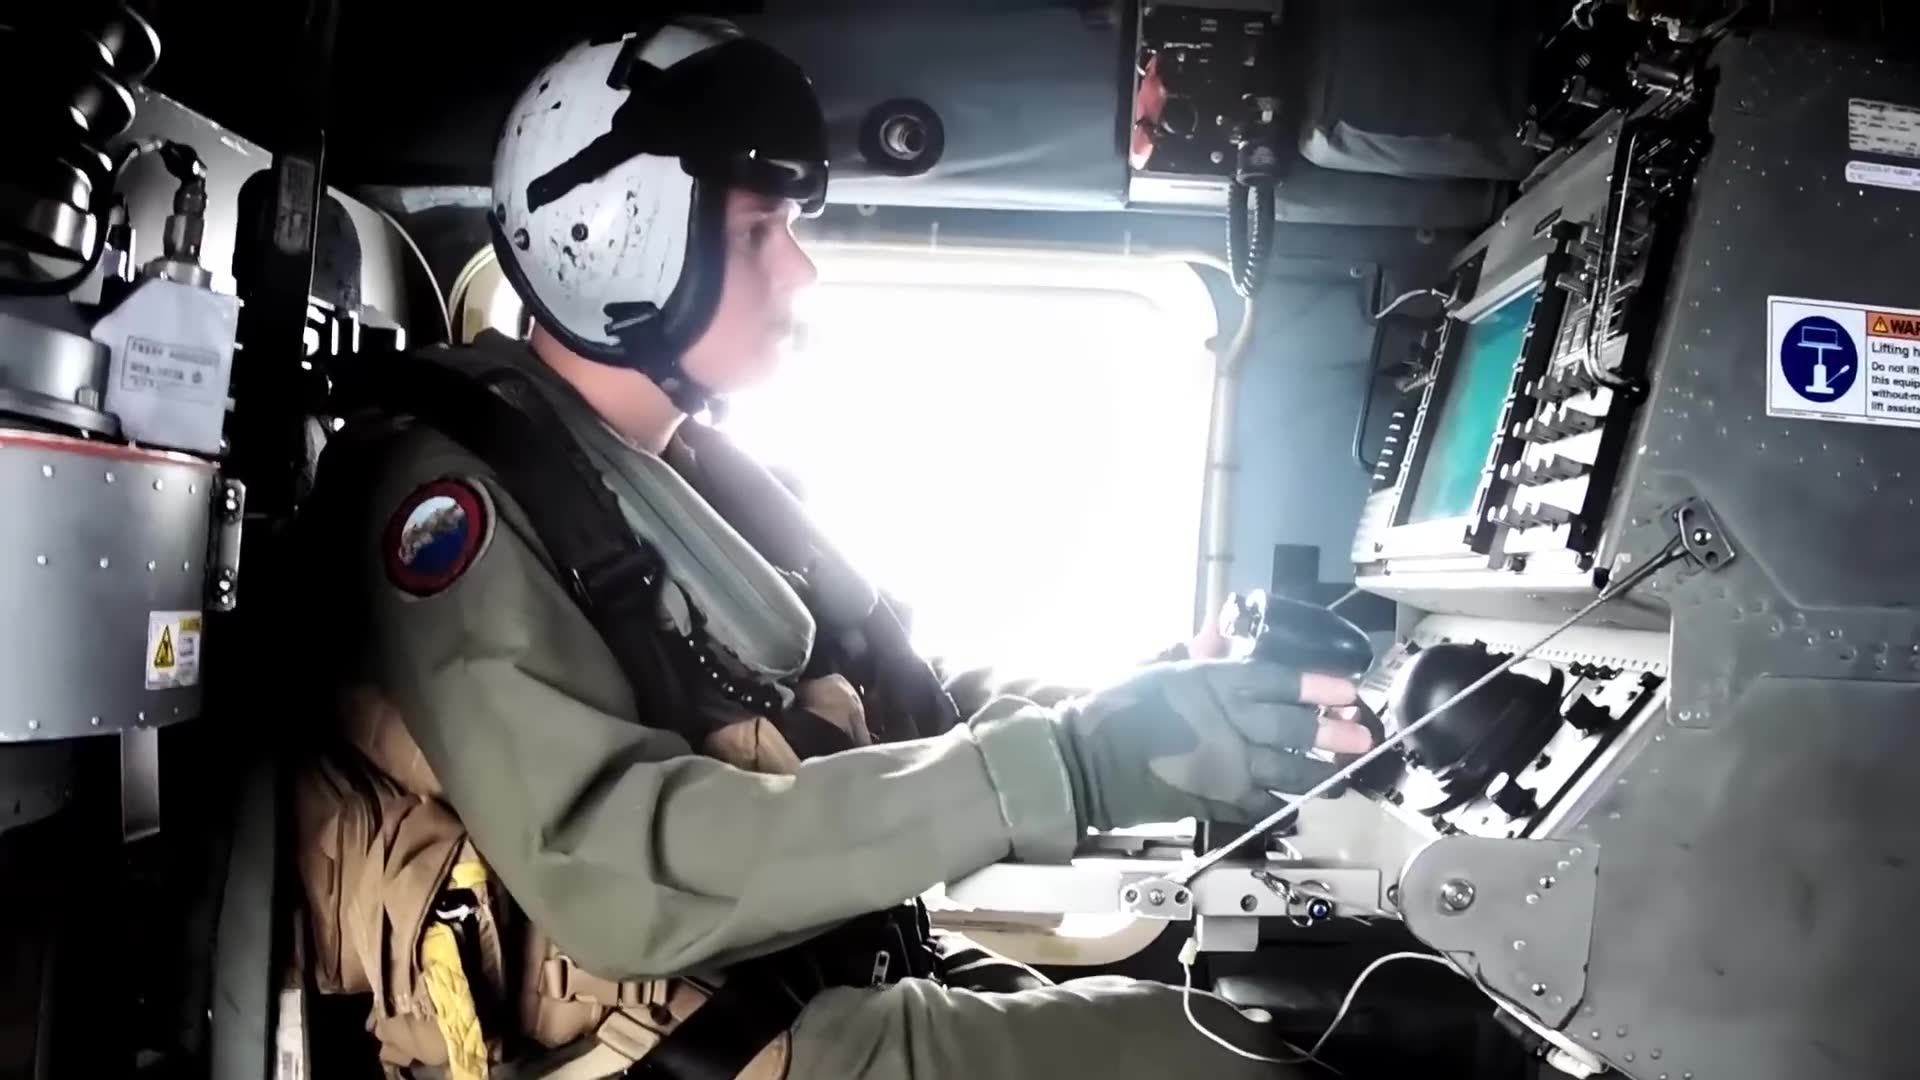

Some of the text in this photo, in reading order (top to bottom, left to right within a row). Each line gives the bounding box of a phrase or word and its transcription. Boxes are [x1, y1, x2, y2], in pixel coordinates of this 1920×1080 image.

[1872, 342, 1909, 358] Lifting
[1871, 361, 1885, 371] Do
[1888, 364, 1904, 373] not
[1871, 375, 1890, 385] this
